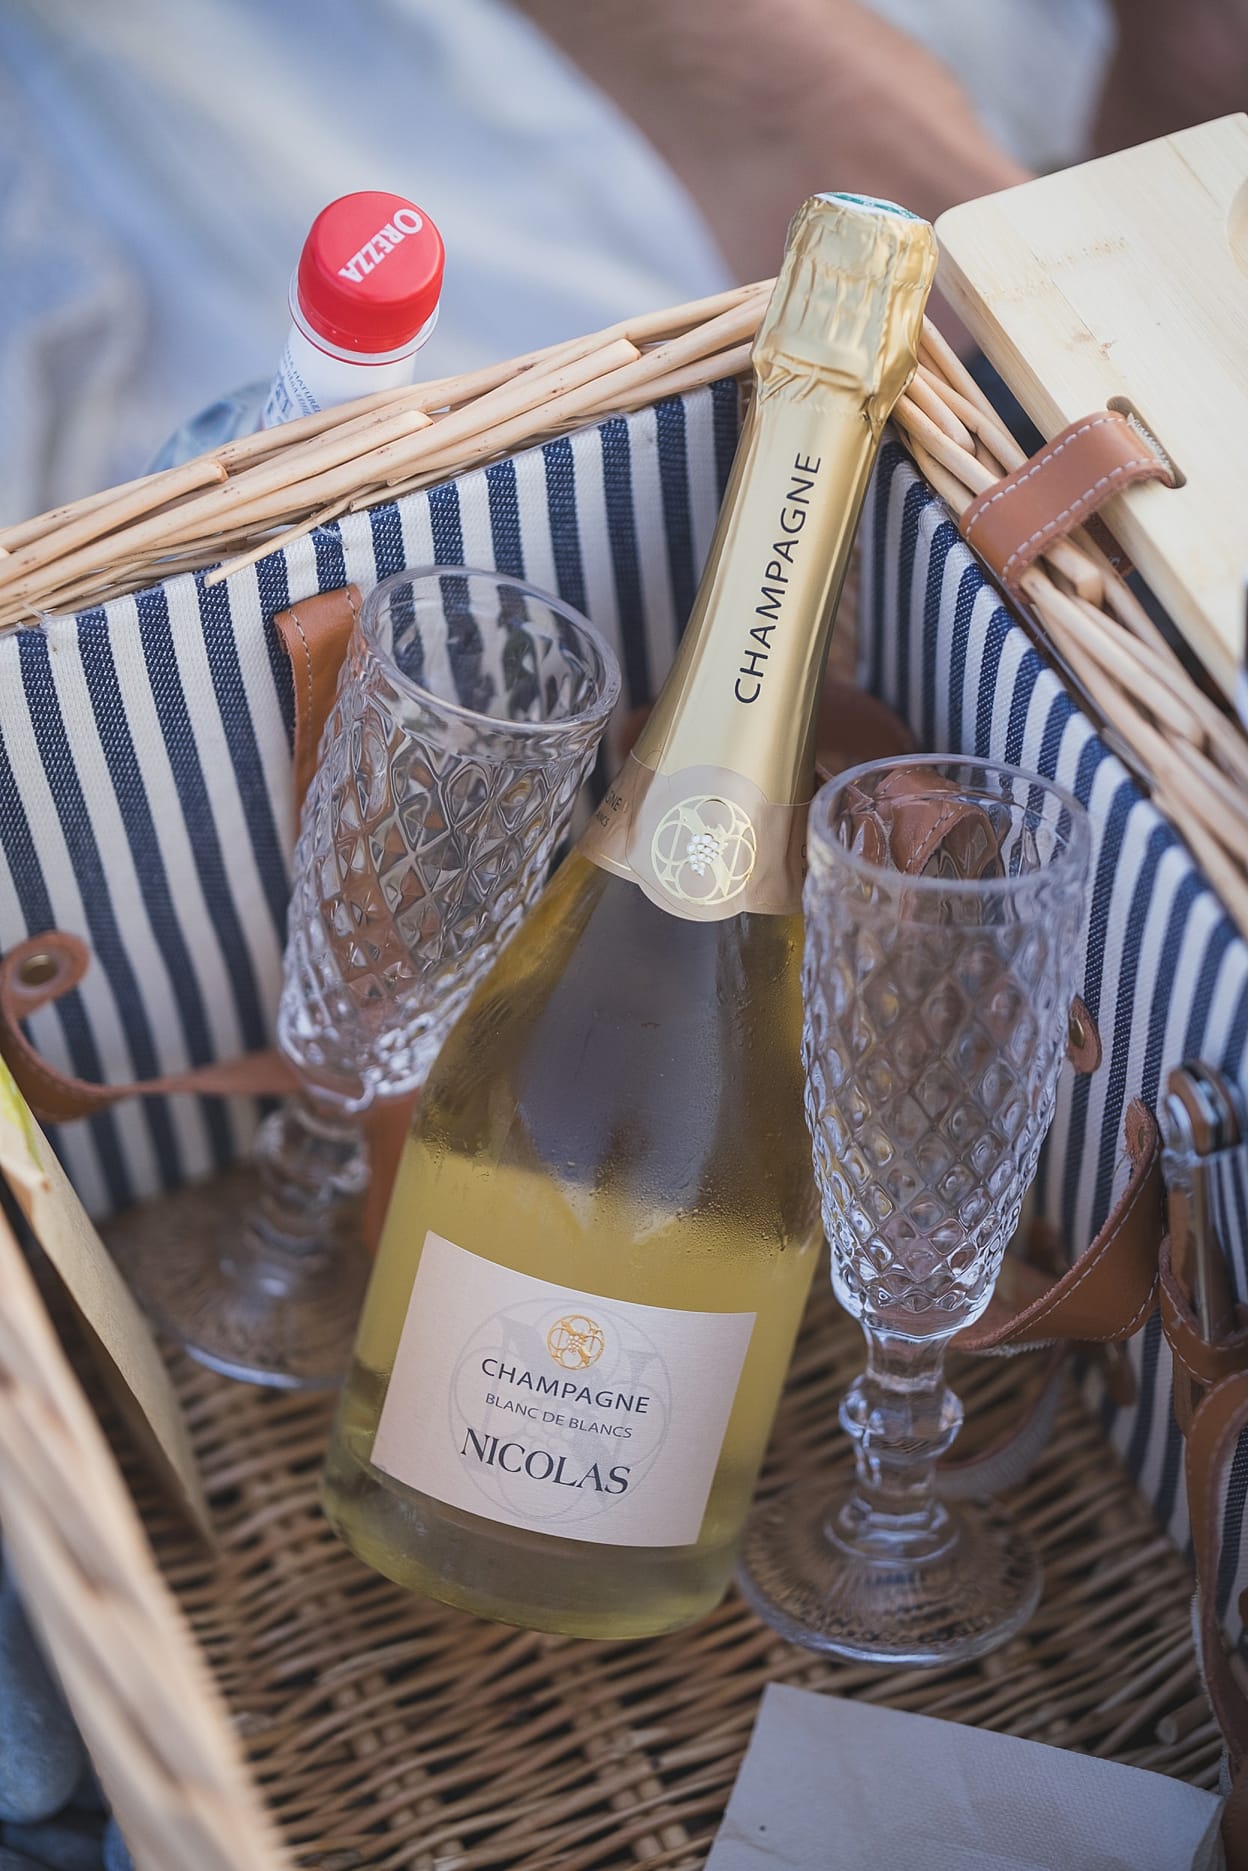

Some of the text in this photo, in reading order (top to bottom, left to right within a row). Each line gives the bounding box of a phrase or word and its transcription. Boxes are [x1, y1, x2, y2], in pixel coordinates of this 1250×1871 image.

[337, 208, 423, 283] OREZZA
[734, 452, 821, 704] CHAMPAGNE
[481, 1358, 650, 1414] CHAMPAGNE
[485, 1393, 633, 1439] BLANC DE BLANCS
[460, 1427, 631, 1495] NICOLAS
